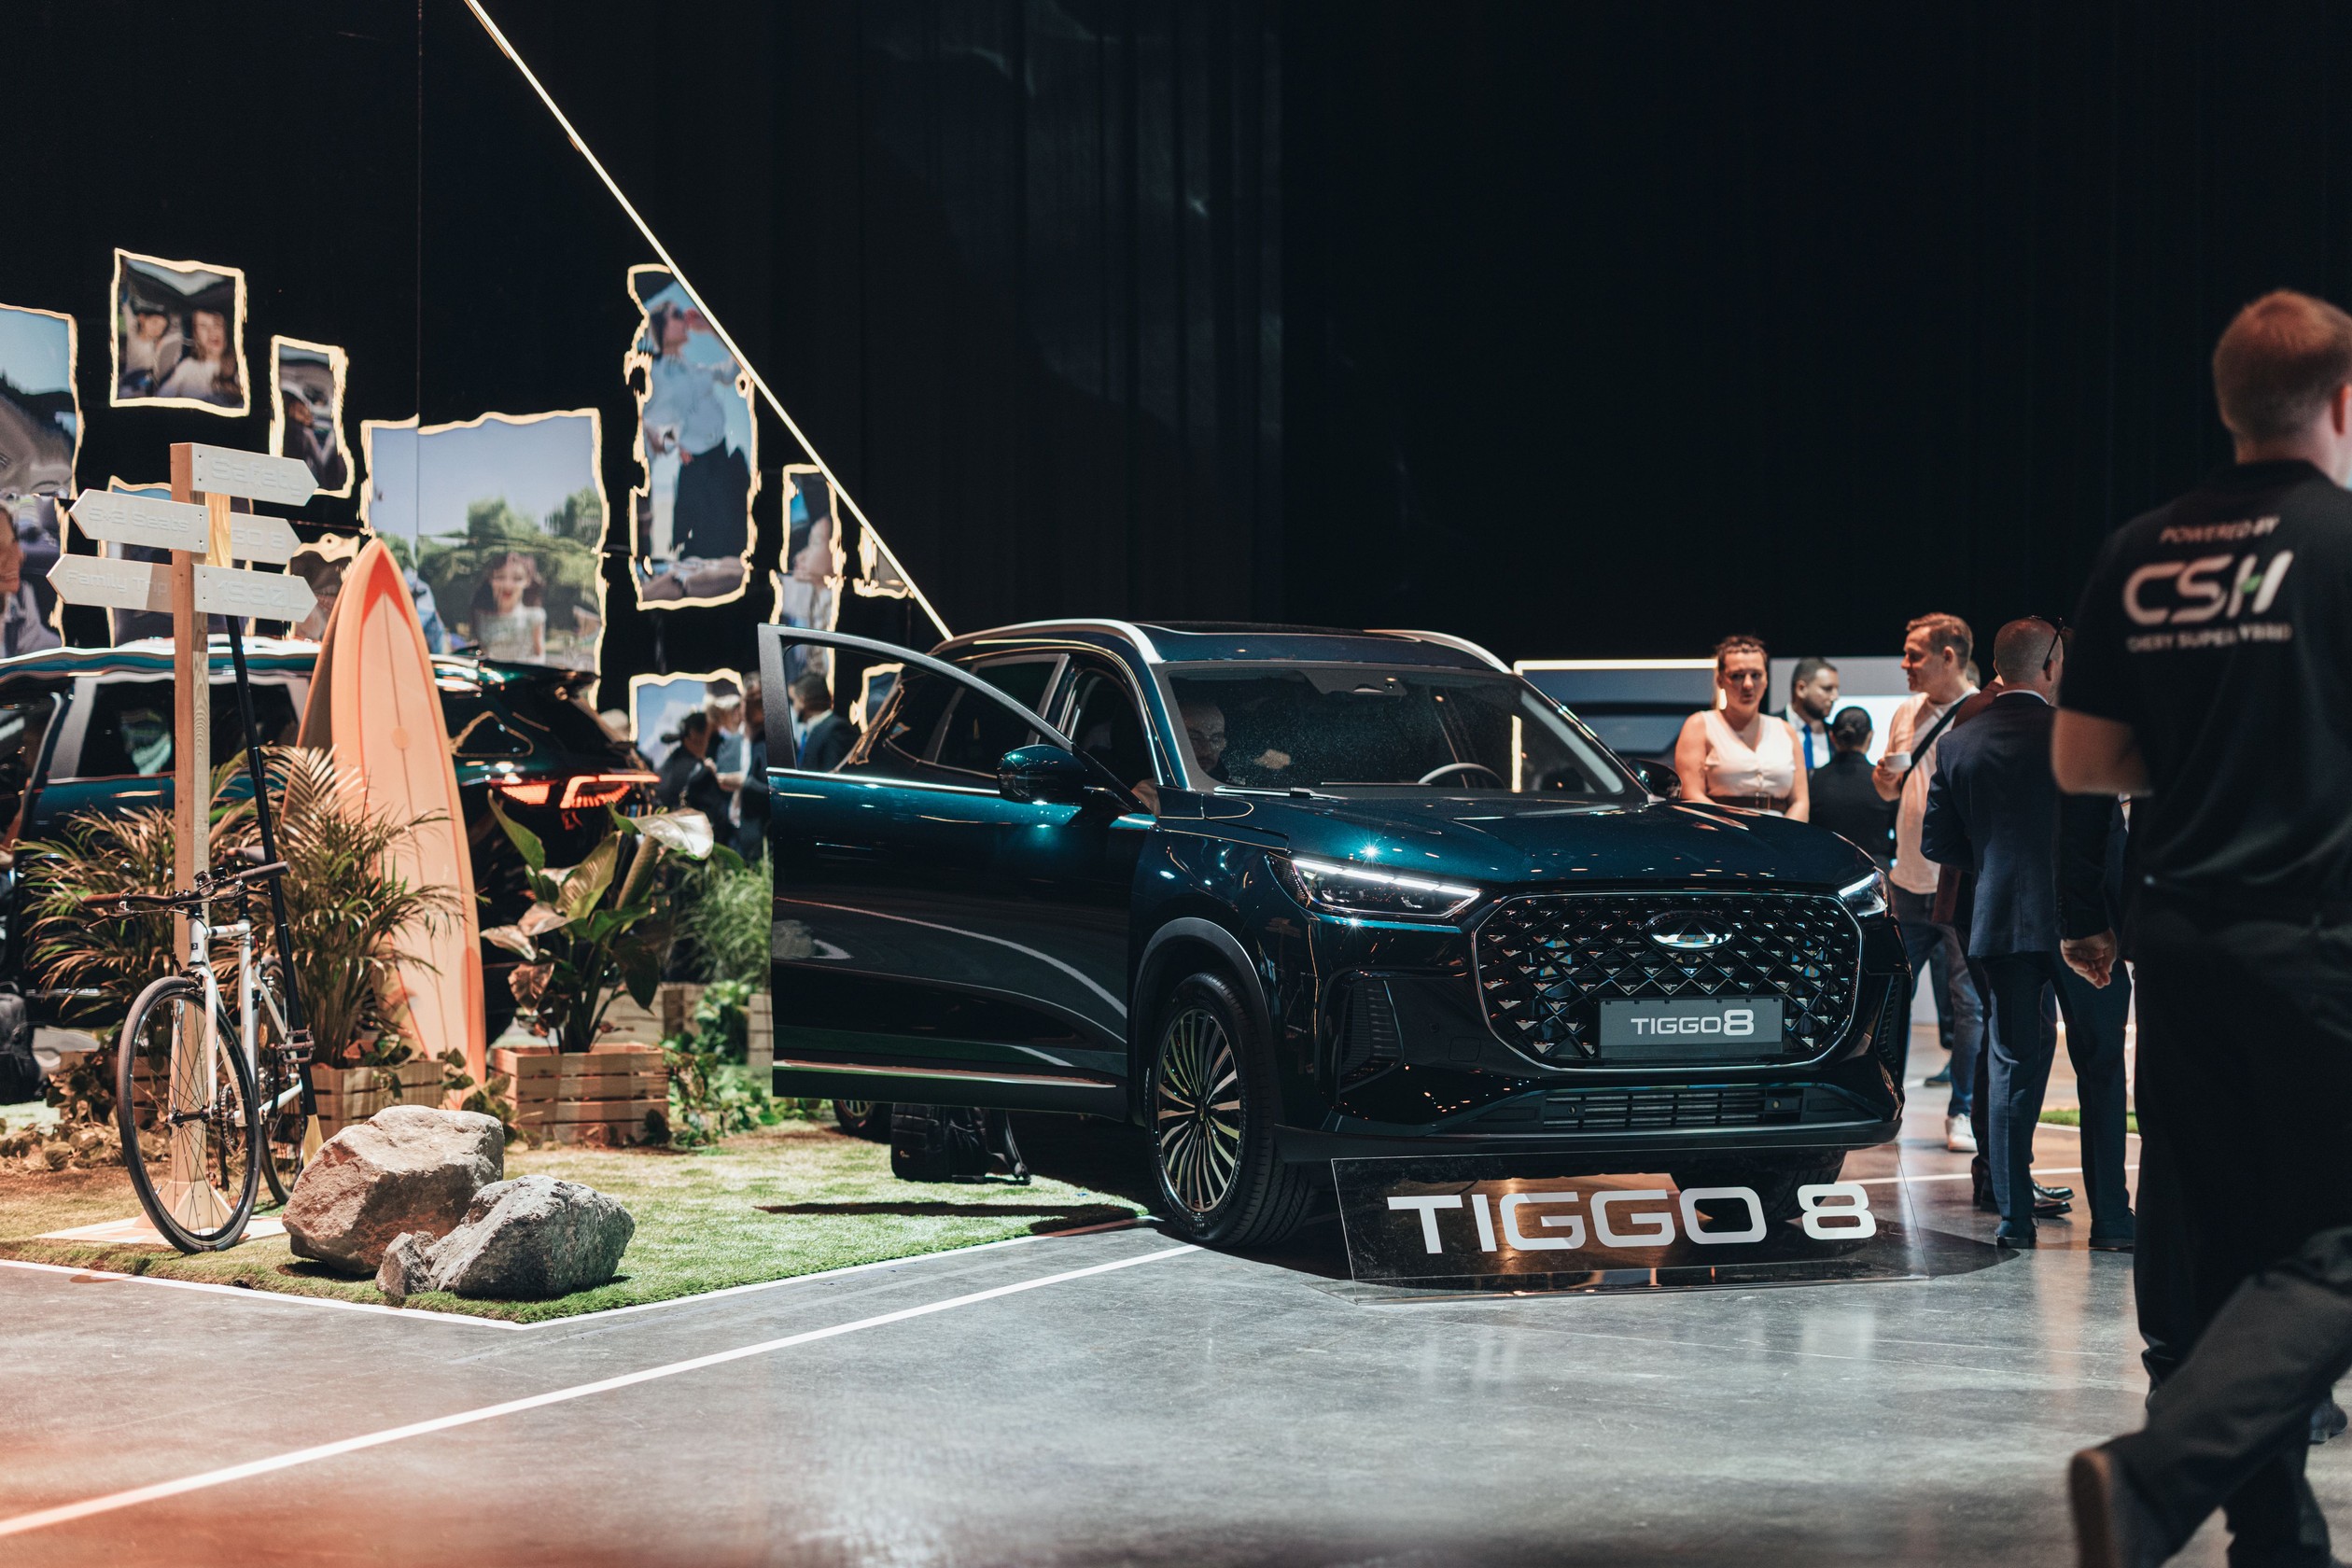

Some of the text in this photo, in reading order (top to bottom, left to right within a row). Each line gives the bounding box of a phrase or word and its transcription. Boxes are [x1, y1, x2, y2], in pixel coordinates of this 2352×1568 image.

[211, 457, 304, 497] Safety
[133, 511, 190, 533] Seats
[65, 569, 168, 597] Family Trip
[2122, 549, 2294, 626] CSH
[1387, 1183, 1877, 1253] TIGGO 8
